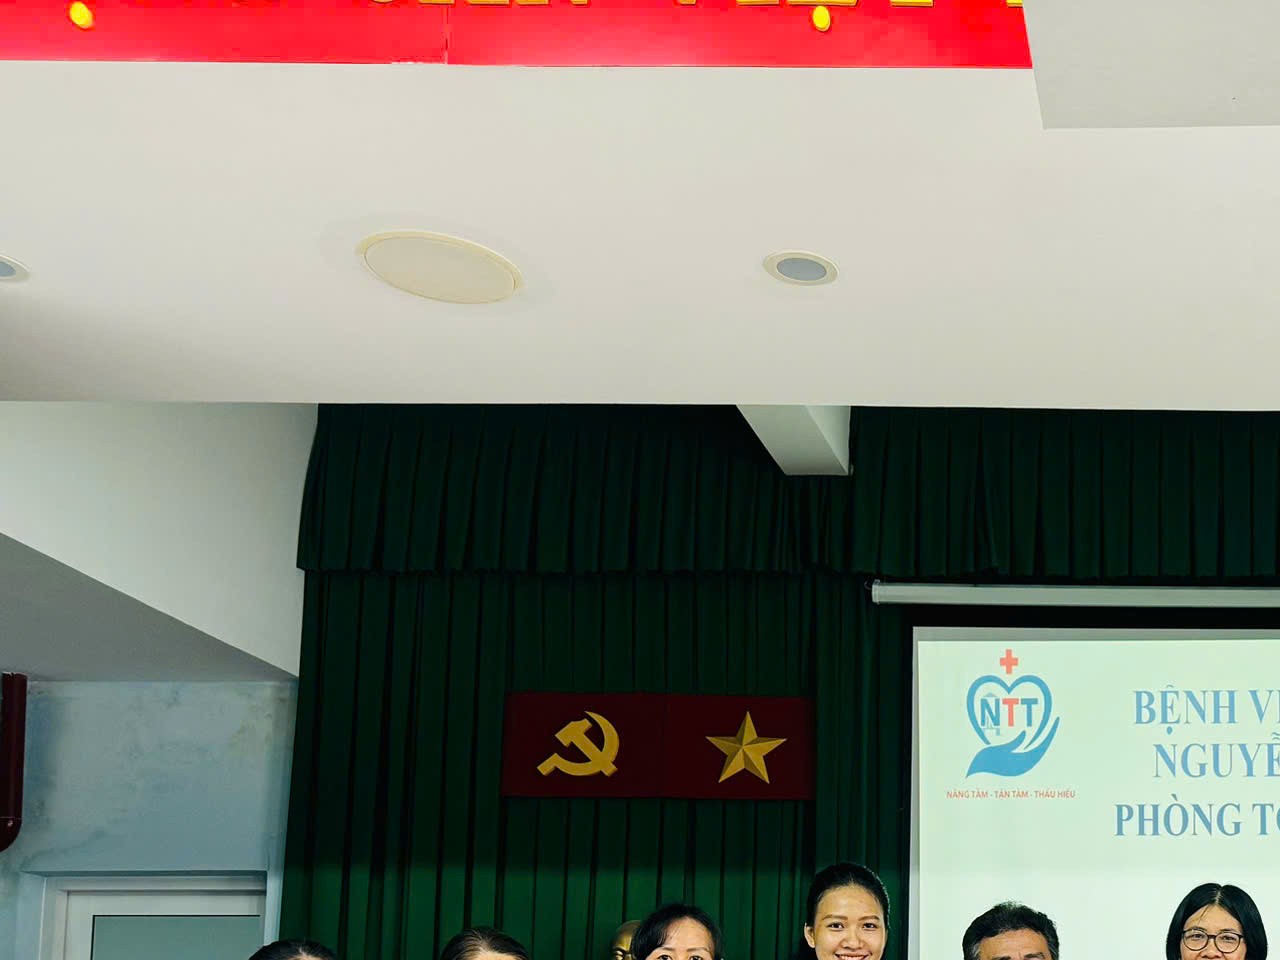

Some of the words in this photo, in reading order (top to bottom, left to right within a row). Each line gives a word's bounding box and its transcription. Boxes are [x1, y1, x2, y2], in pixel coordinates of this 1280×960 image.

[980, 698, 1038, 727] NTT
[1134, 684, 1238, 736] BỆNH
[1115, 792, 1242, 837] PHÒNG
